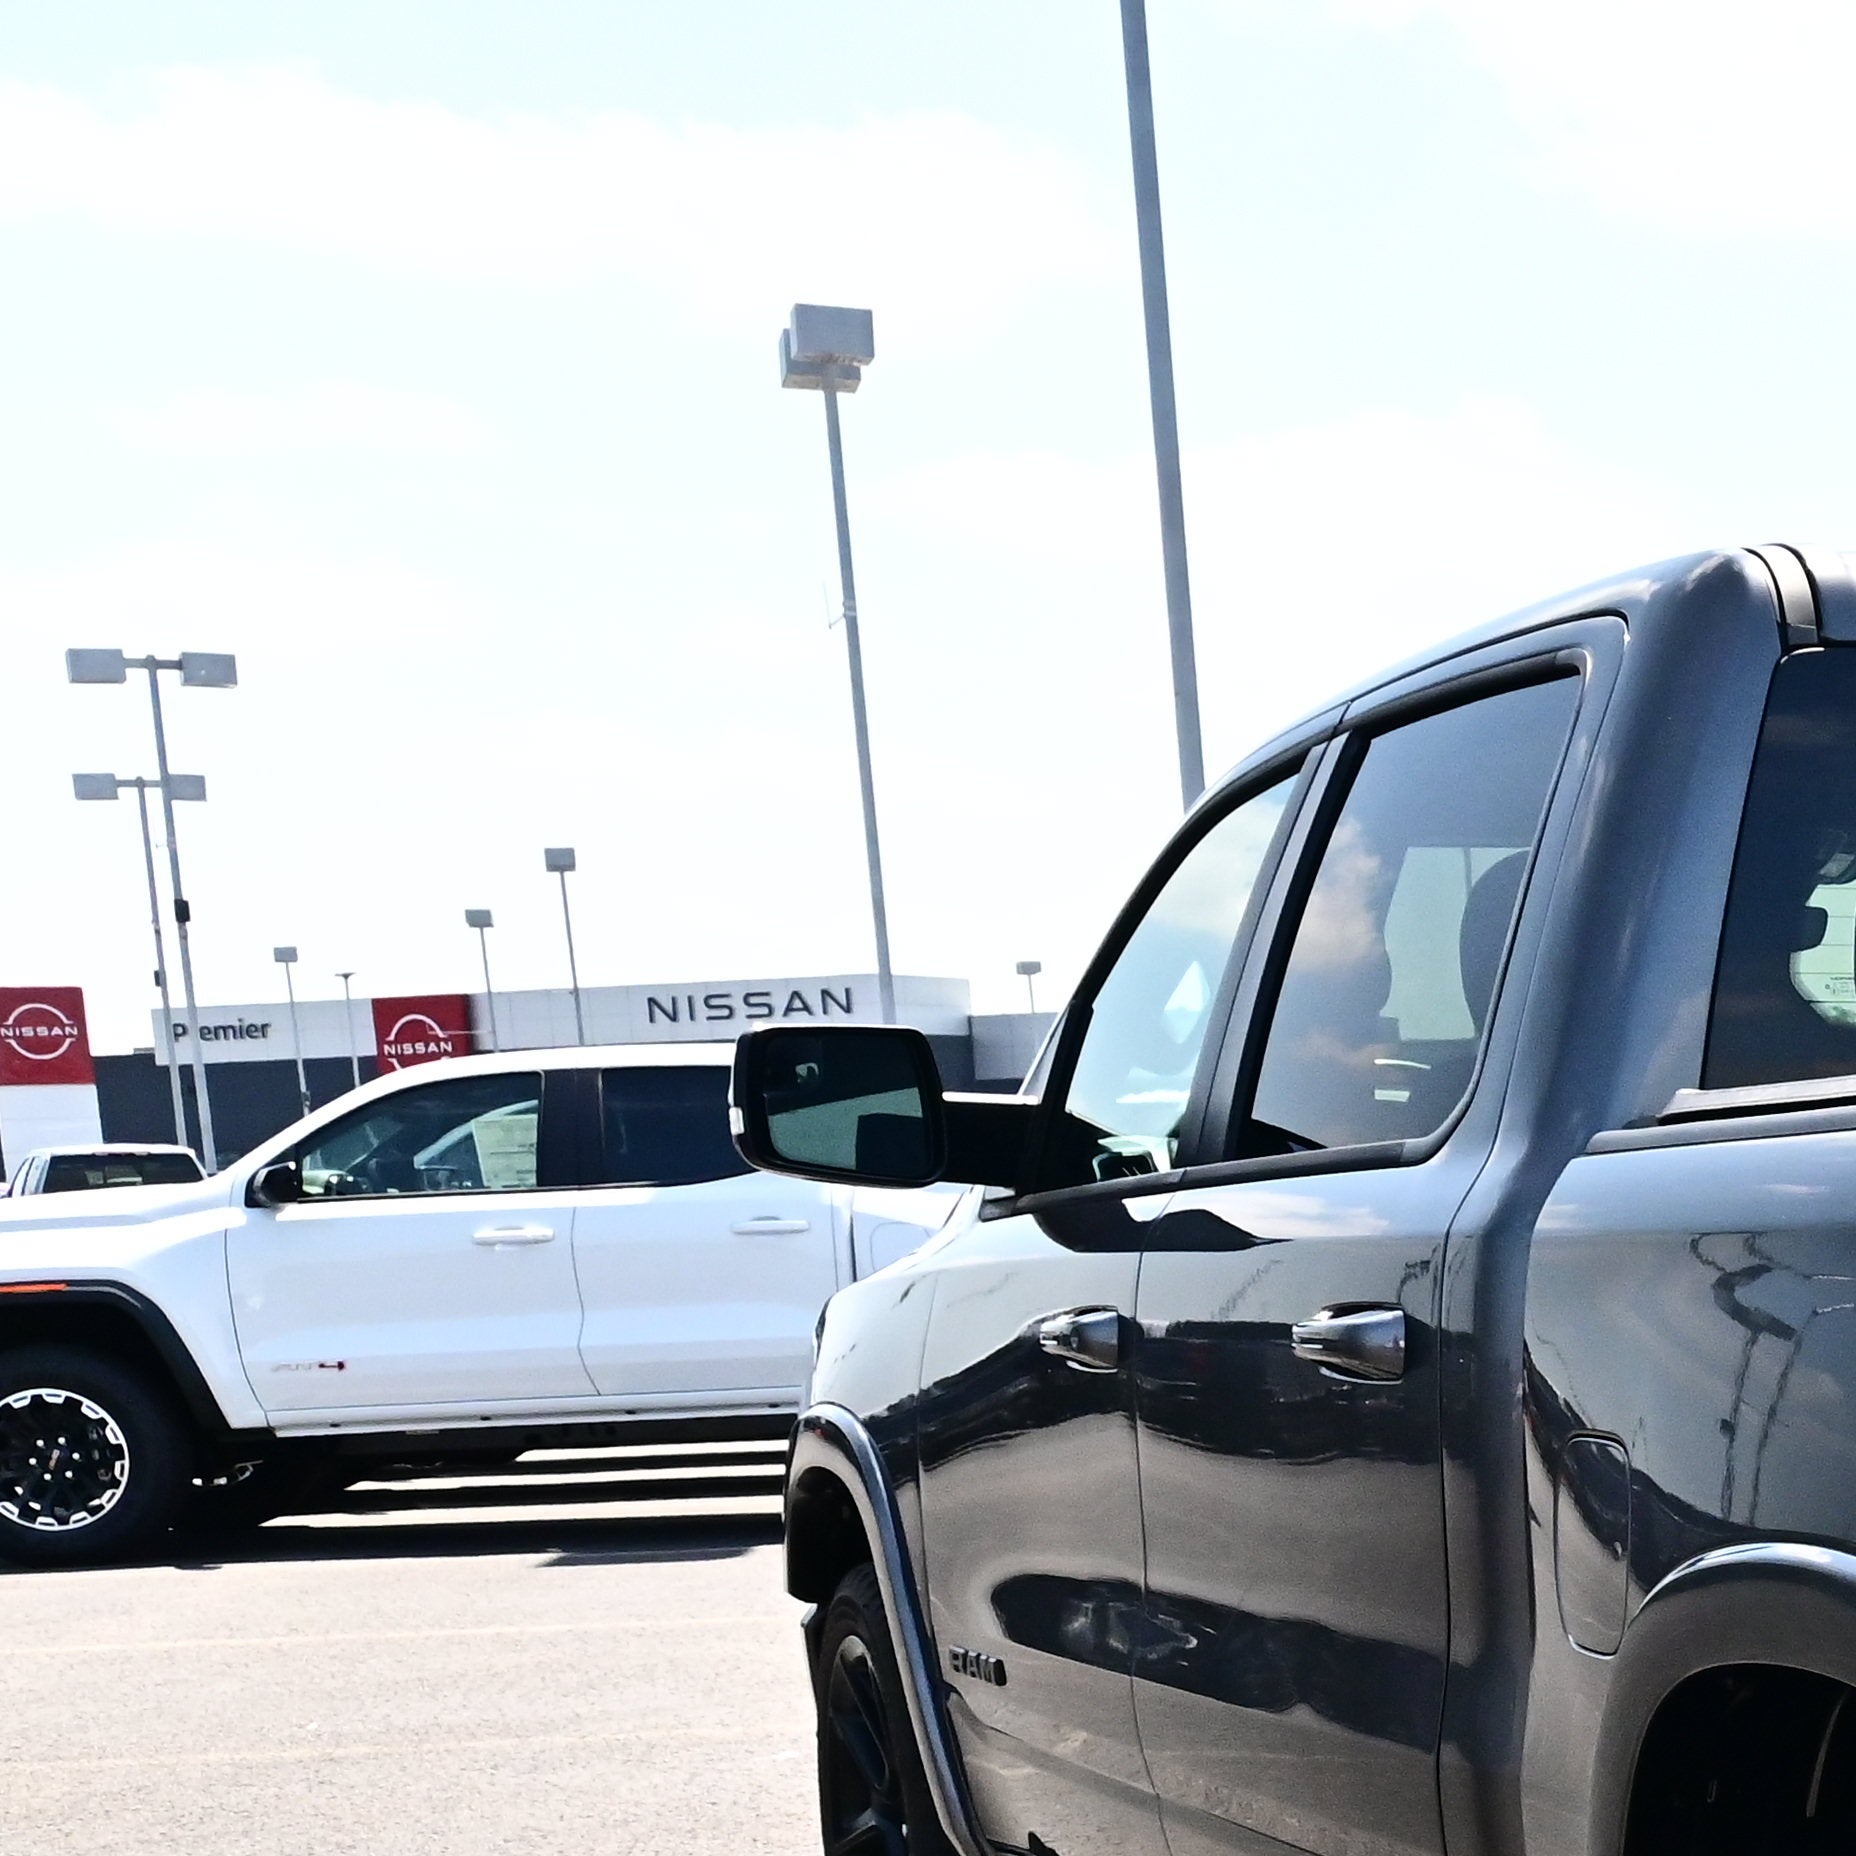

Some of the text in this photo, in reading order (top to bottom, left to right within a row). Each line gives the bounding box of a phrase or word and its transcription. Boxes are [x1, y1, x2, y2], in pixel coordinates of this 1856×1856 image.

[647, 988, 854, 1024] NISSAN
[0, 1026, 78, 1037] NISSAN
[173, 1018, 271, 1042] Pemier
[383, 1041, 453, 1056] NISSAN
[948, 1645, 1007, 1687] RAM
